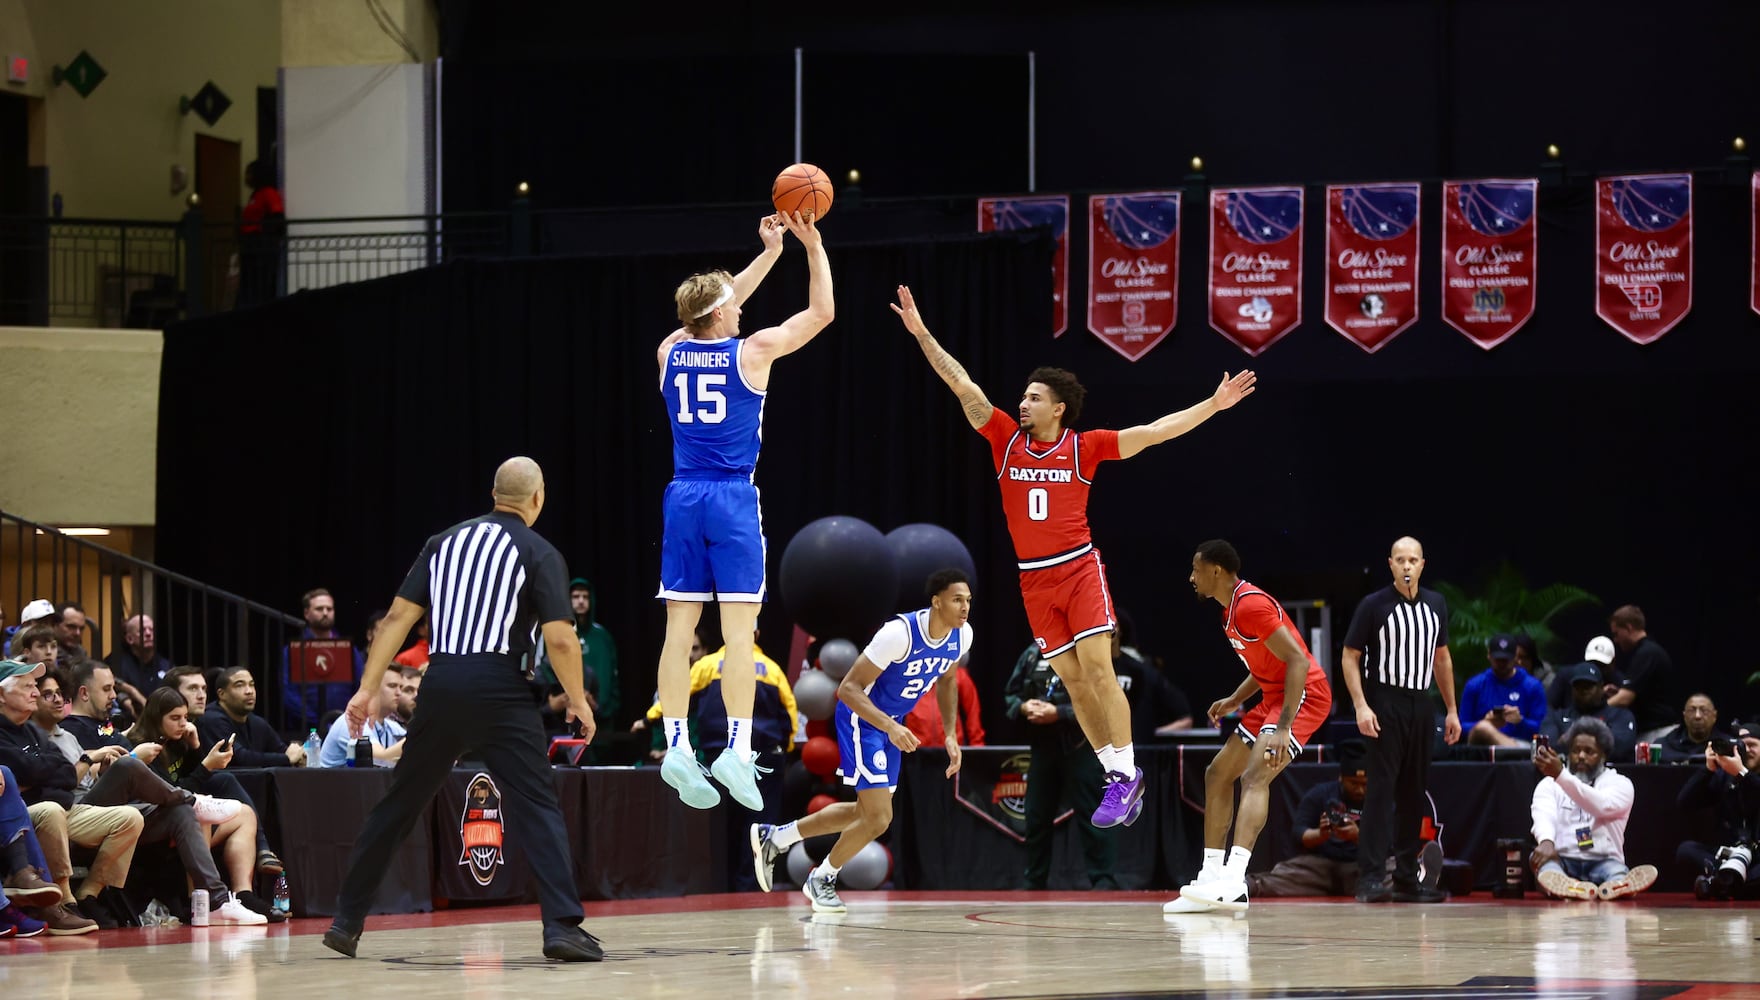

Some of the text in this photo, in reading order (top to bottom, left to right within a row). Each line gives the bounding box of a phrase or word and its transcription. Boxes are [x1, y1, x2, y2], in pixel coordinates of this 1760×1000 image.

[1338, 248, 1406, 268] Old Spice
[1455, 244, 1523, 265] Old Spice
[1610, 240, 1679, 262] Old Spice
[1101, 256, 1168, 278] Old Spice
[1222, 251, 1290, 273] Old Spice
[1624, 261, 1665, 272] CLASSIC
[1235, 272, 1276, 282] CLASSIC
[1352, 269, 1393, 279] CLASSIC
[1469, 265, 1510, 275] CLASSIC
[1115, 277, 1154, 288] CLASSIC
[1476, 276, 1529, 287] CHAMPION
[1604, 272, 1685, 284] 2011 CHAMPION
[1243, 286, 1293, 296] CHAMPION
[1361, 282, 1411, 293] CHAMPION
[672, 351, 730, 367] SAUNDERS
[674, 373, 727, 423] 15
[1009, 467, 1073, 482] DAYTON
[1028, 488, 1048, 521] 0
[903, 657, 953, 676] BYU
